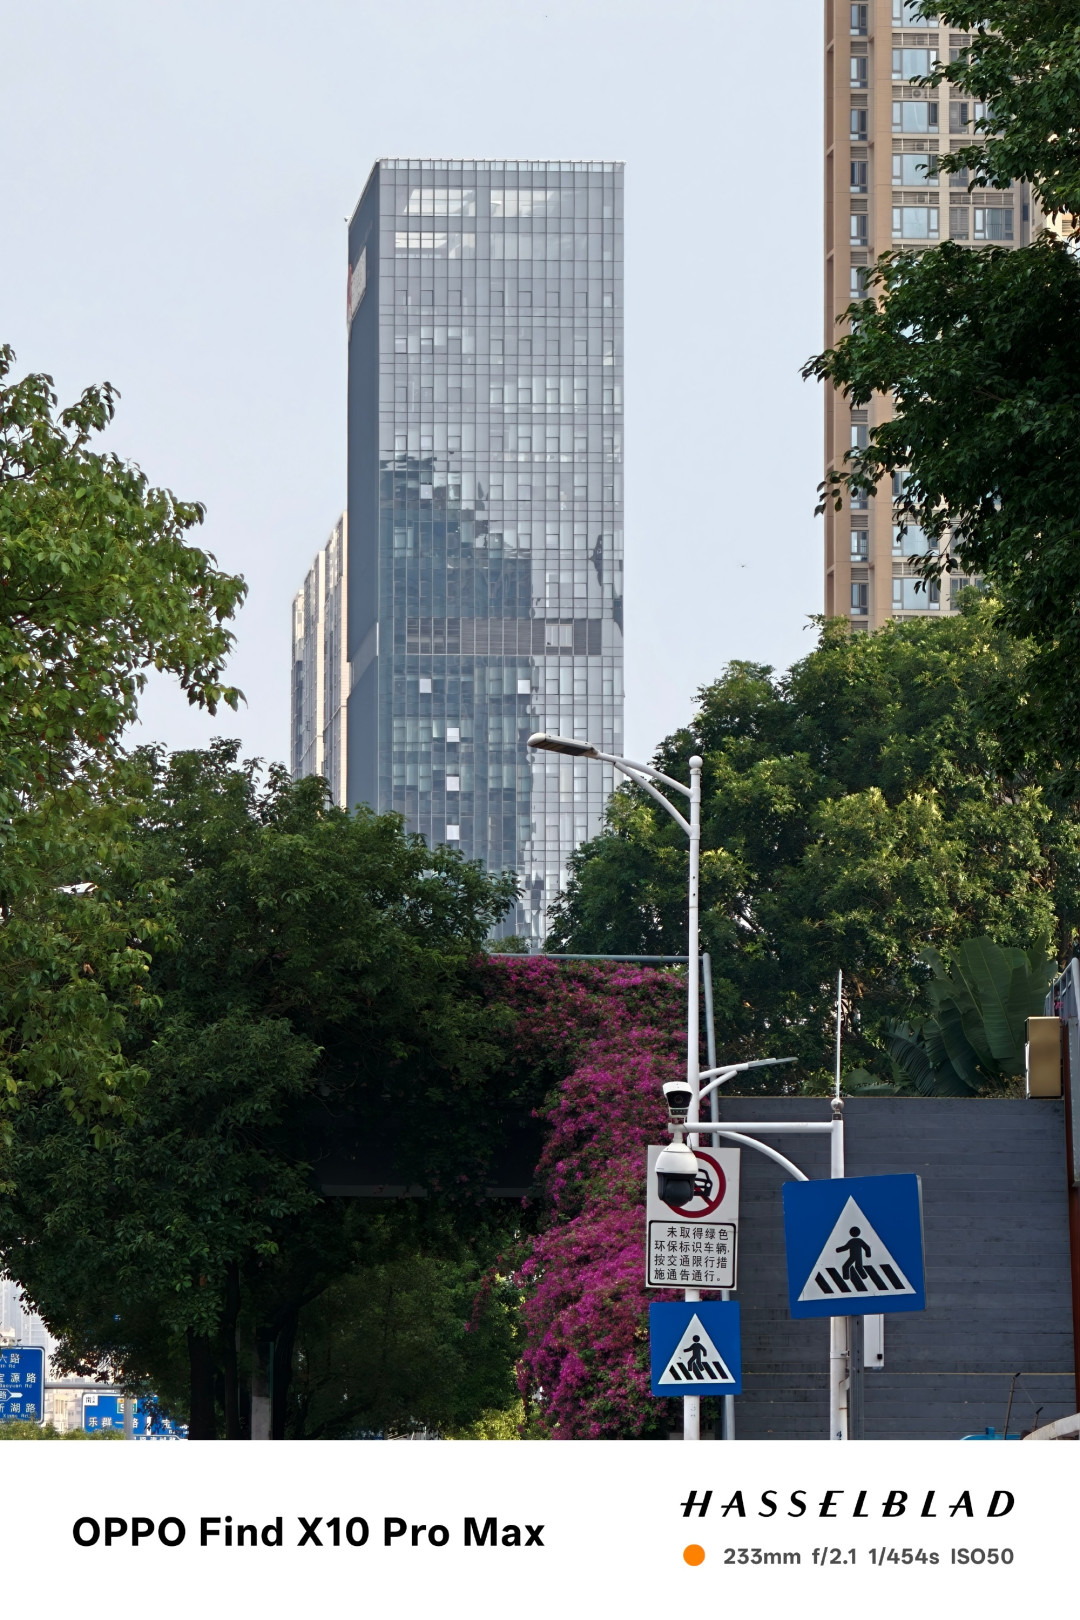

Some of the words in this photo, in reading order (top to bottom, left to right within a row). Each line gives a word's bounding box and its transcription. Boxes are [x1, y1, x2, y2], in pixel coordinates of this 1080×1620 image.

[667, 1226, 728, 1240] 未取得绿色
[654, 1254, 728, 1269] 按交通限行措
[654, 1268, 720, 1282] 施通告通行。
